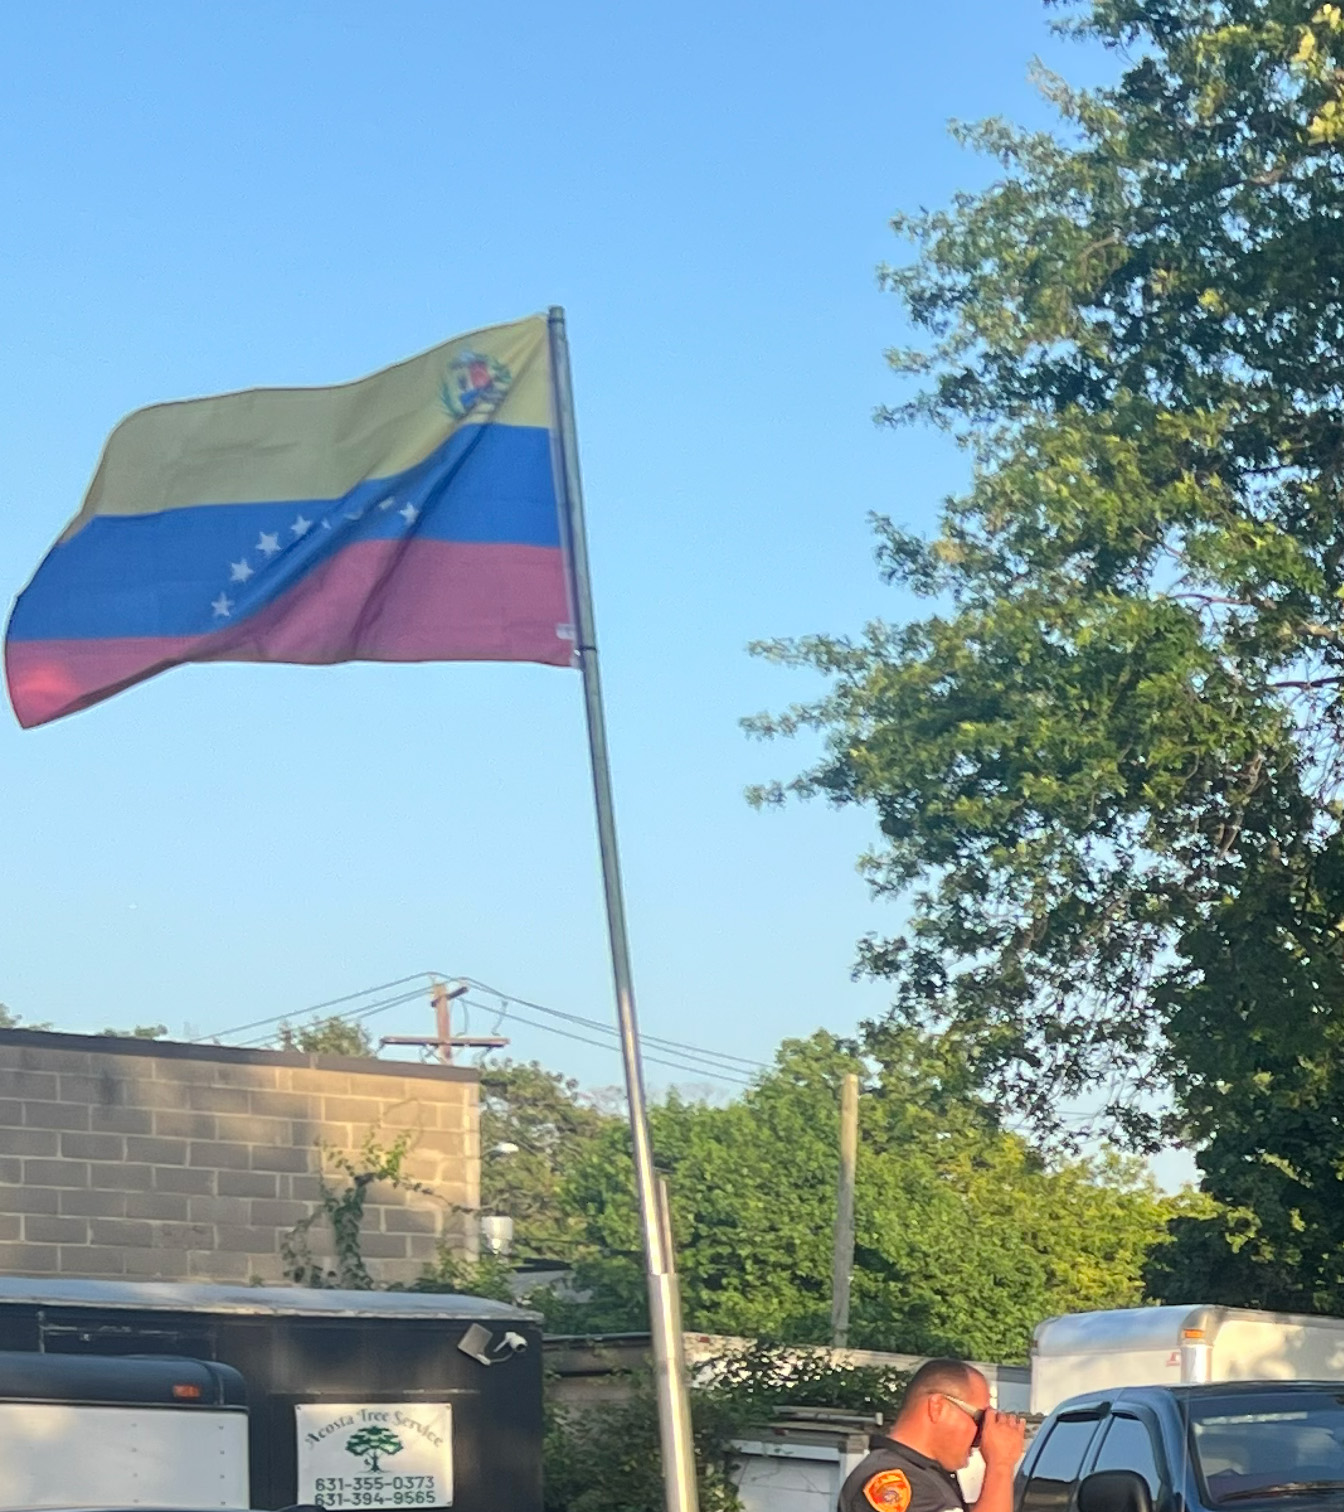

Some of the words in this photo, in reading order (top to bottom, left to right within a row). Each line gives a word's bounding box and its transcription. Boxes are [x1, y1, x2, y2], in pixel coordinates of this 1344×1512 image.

[305, 1414, 355, 1449] Acosta
[357, 1408, 390, 1422] Tree
[392, 1410, 444, 1448] Service
[315, 1475, 435, 1492] 631-355-0373
[314, 1491, 437, 1507] 631-394-9565
